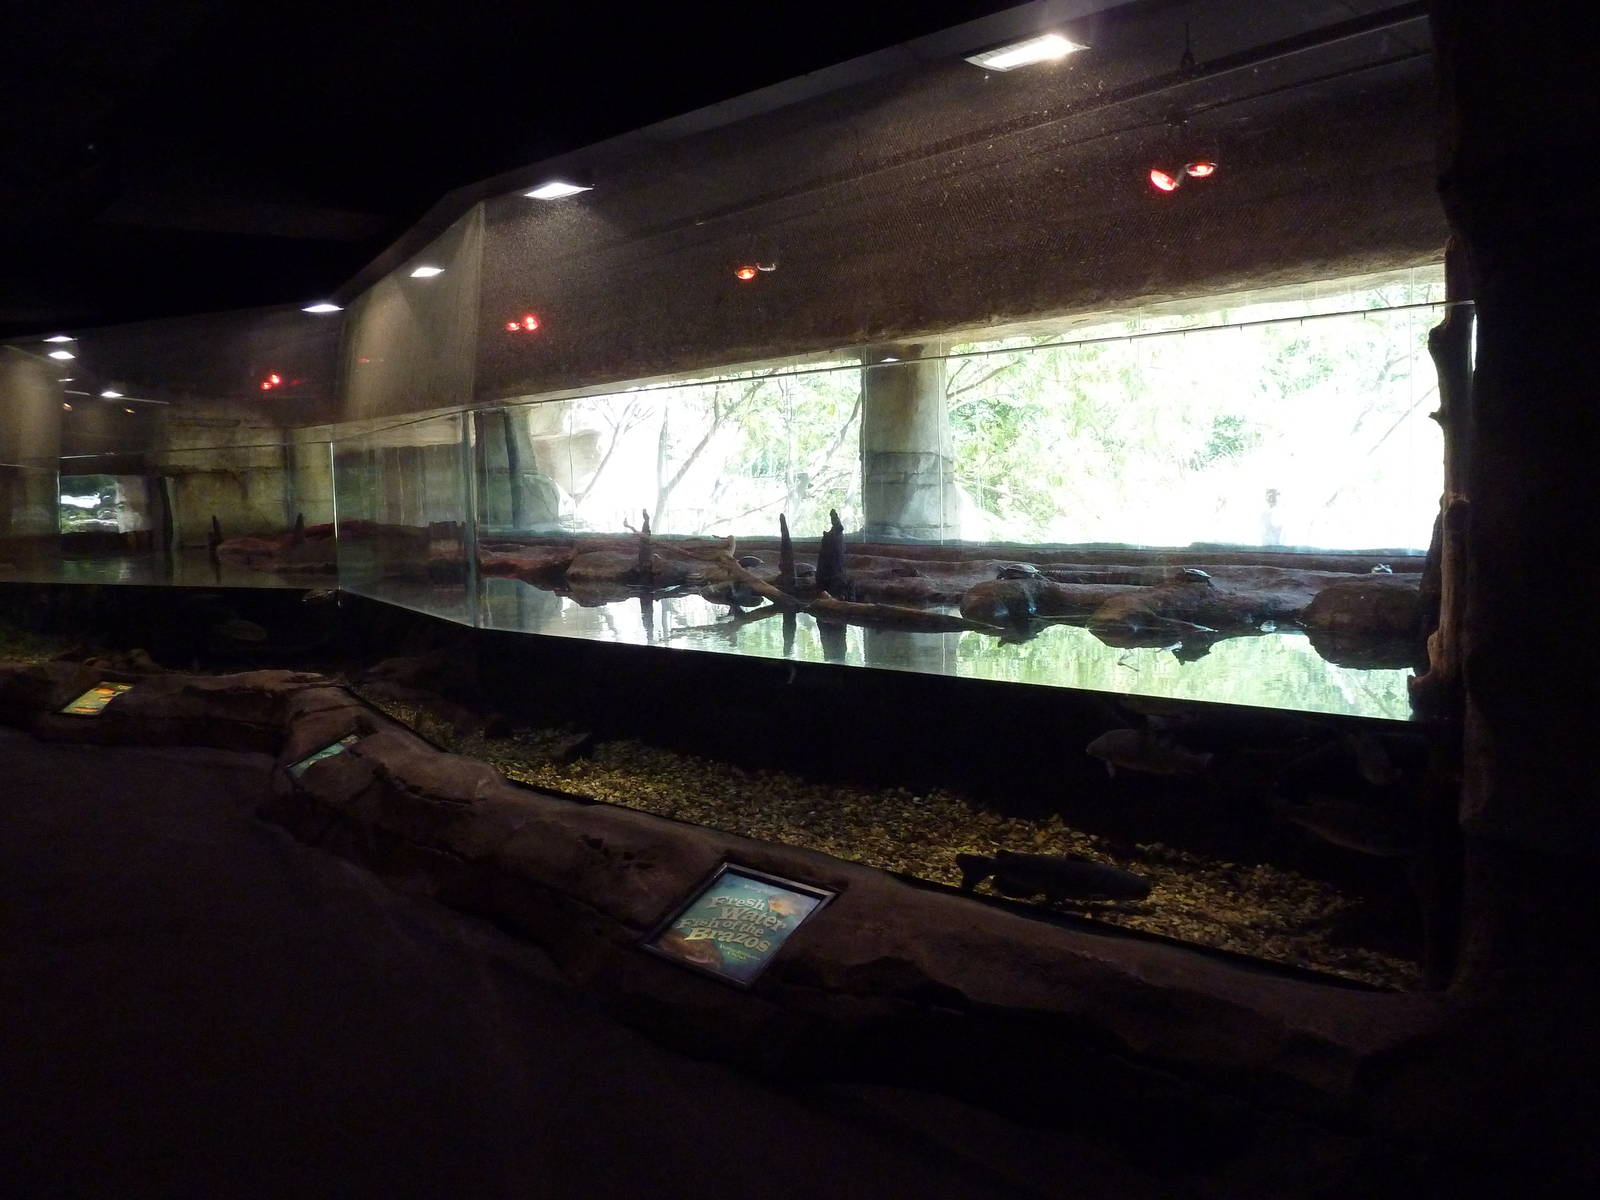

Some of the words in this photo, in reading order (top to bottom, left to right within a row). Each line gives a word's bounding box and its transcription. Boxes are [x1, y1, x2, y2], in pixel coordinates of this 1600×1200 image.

[707, 895, 766, 911] Fresh
[676, 917, 719, 929] Fish
[722, 919, 739, 931] of
[739, 922, 764, 937] the
[717, 906, 787, 931] Water
[684, 927, 771, 952] Brazos
